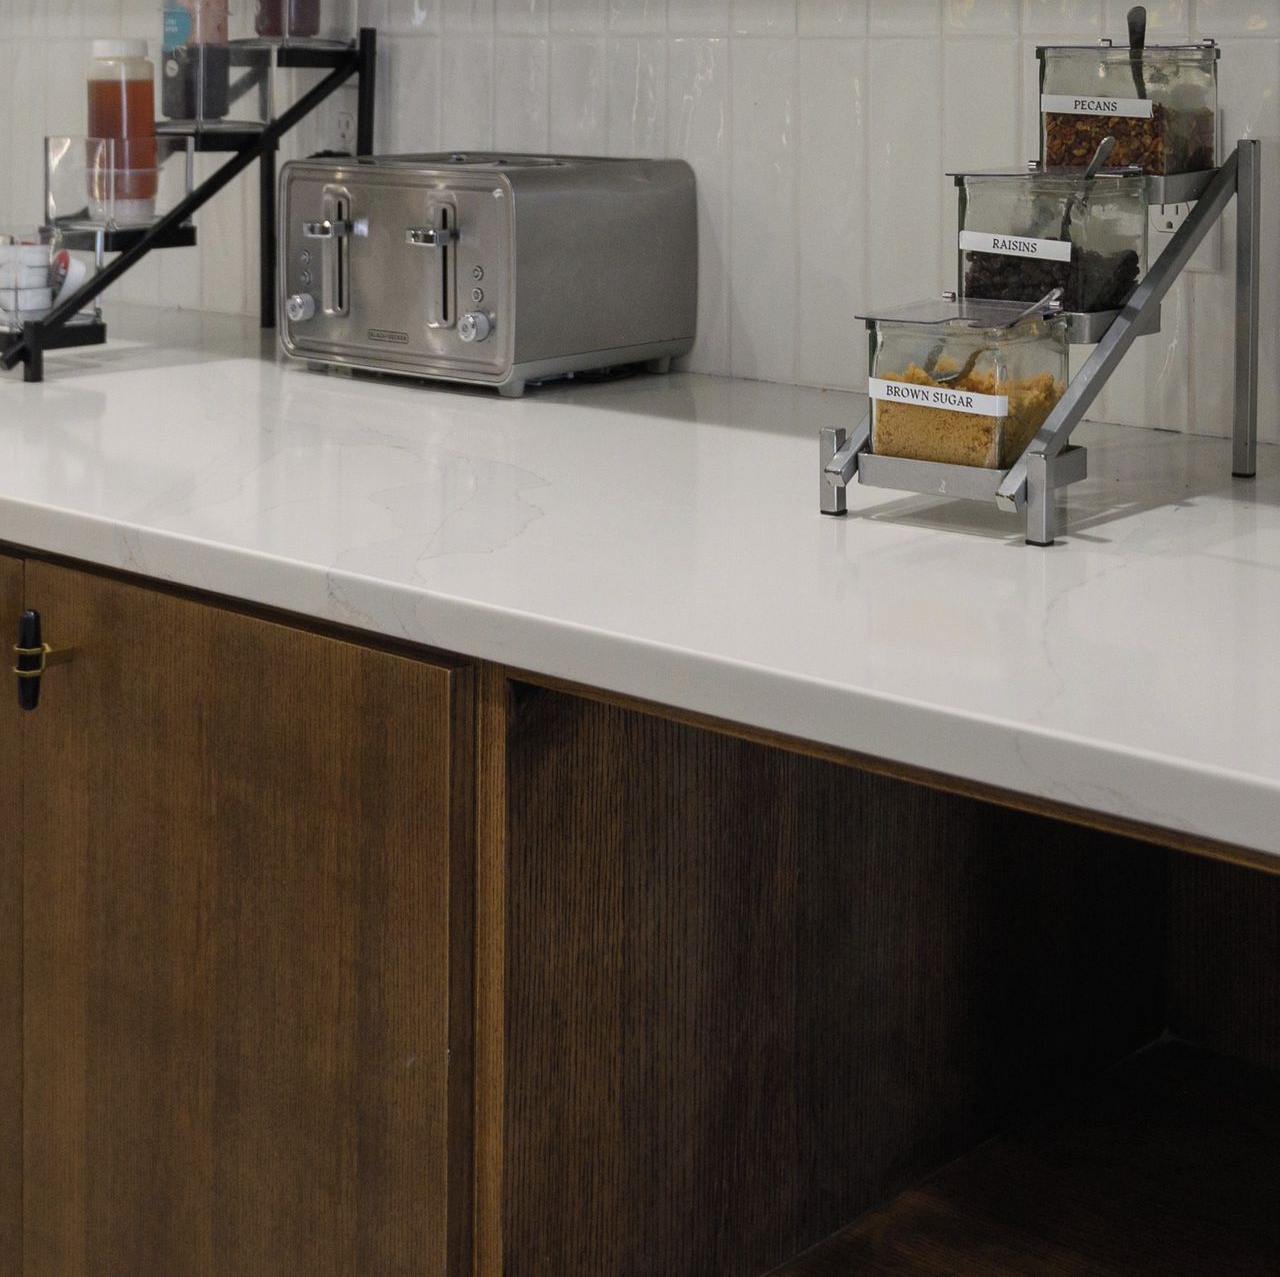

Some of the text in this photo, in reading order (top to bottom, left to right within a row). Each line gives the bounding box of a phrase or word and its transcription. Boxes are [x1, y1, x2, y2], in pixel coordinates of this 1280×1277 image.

[1074, 99, 1118, 112] PECANS
[992, 238, 1038, 253] RAISINS
[886, 385, 974, 408] BROWN SUGAR
